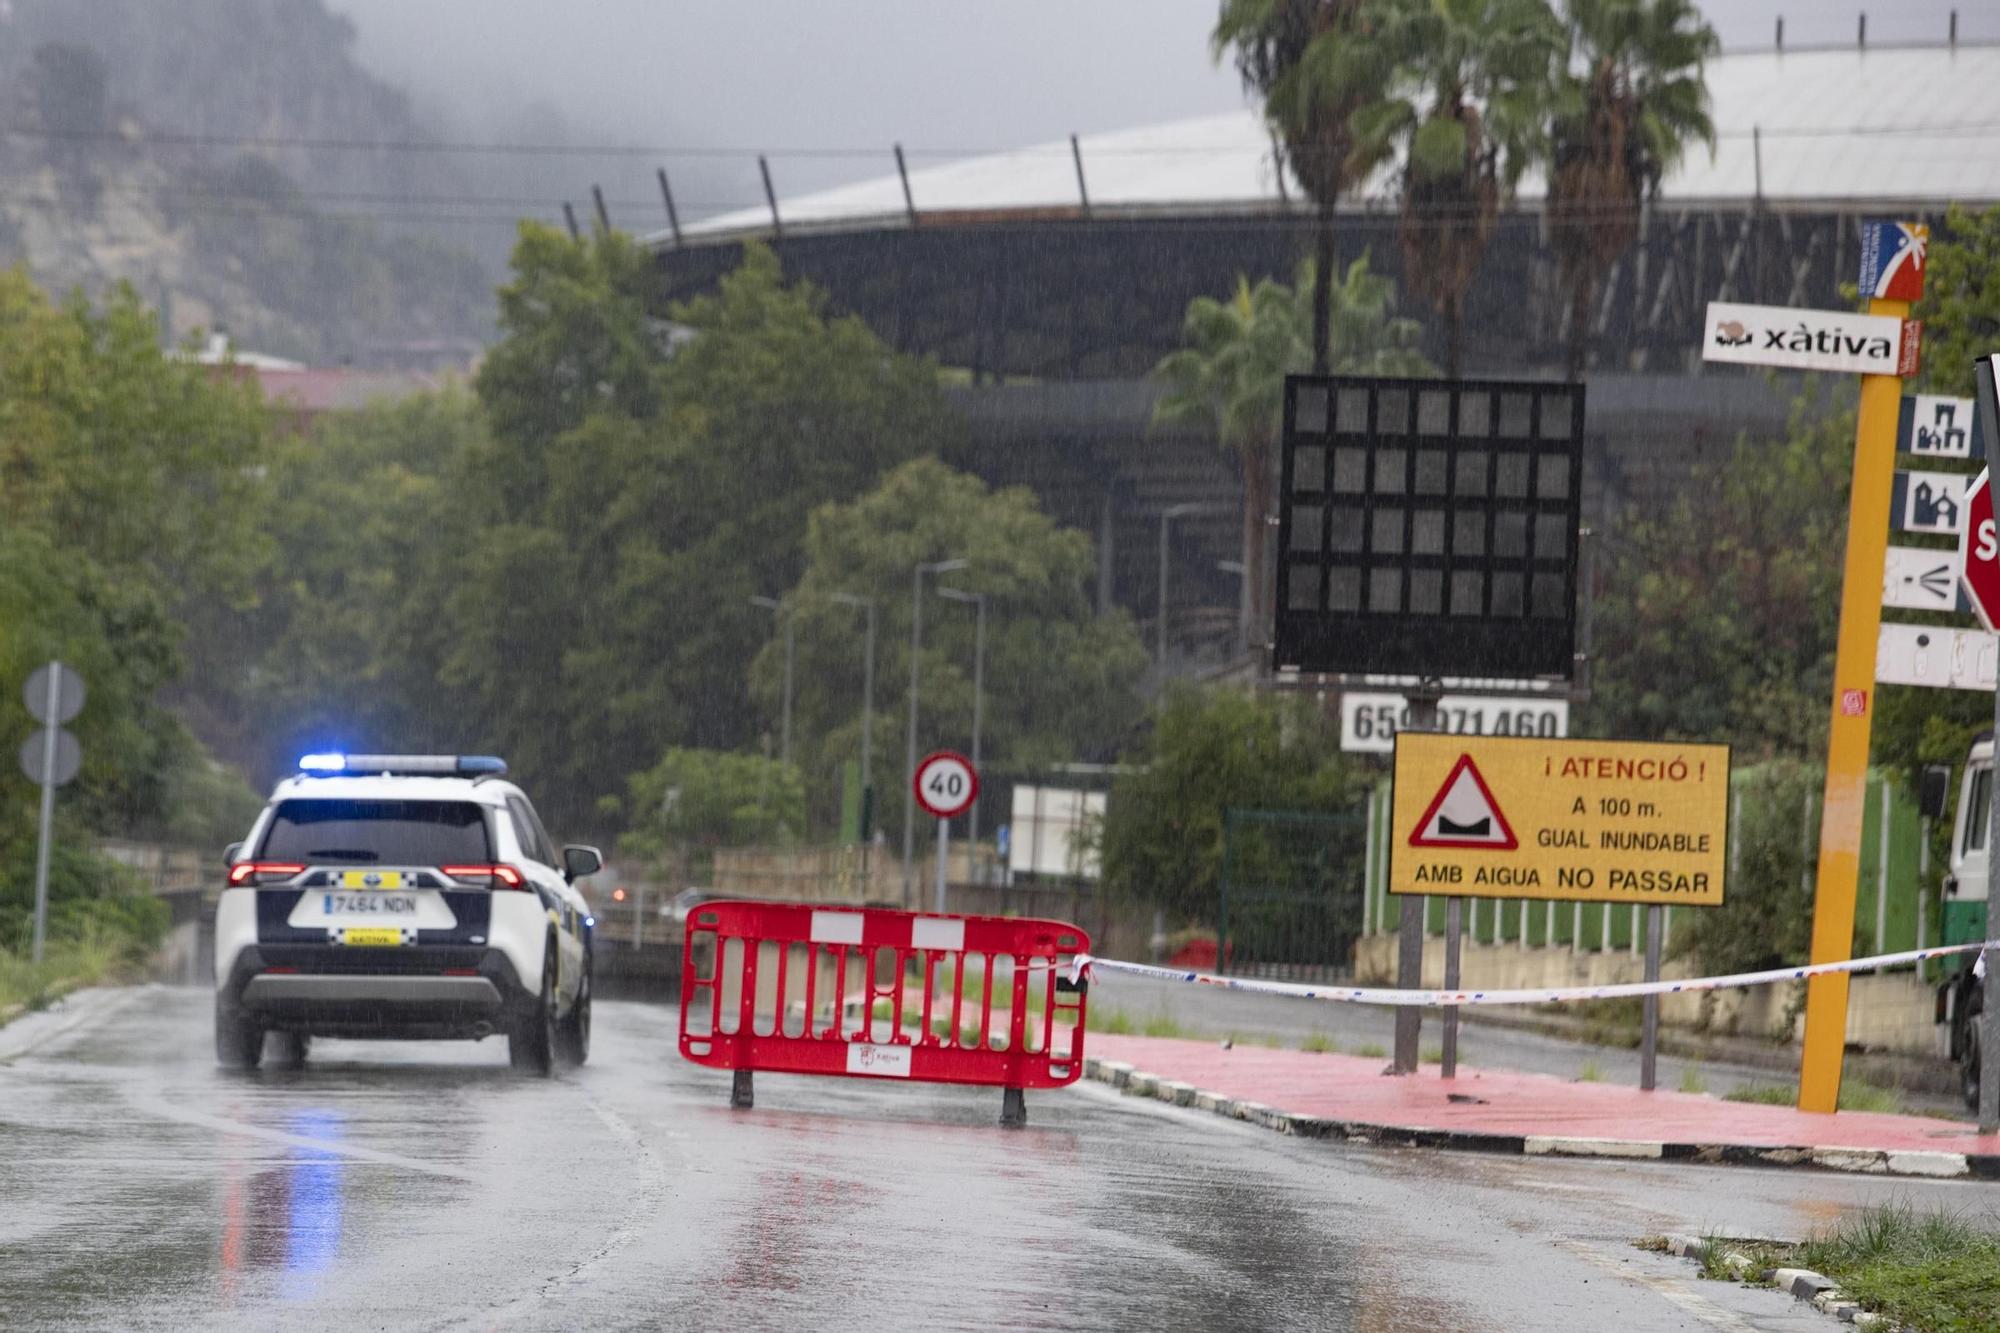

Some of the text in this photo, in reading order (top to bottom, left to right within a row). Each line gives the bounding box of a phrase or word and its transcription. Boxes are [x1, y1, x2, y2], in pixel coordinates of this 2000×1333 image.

[1764, 323, 1891, 359] xàtiva
[1561, 754, 1688, 781] ATENCIÓ
[929, 771, 962, 797] 40
[1572, 796, 1586, 815] A
[1600, 797, 1631, 816] 100
[1537, 828, 1710, 853] GUAL INUNDABLE
[1415, 863, 1709, 893] AMB AIGUA NO PASSAR
[384, 897, 417, 912] NDN
